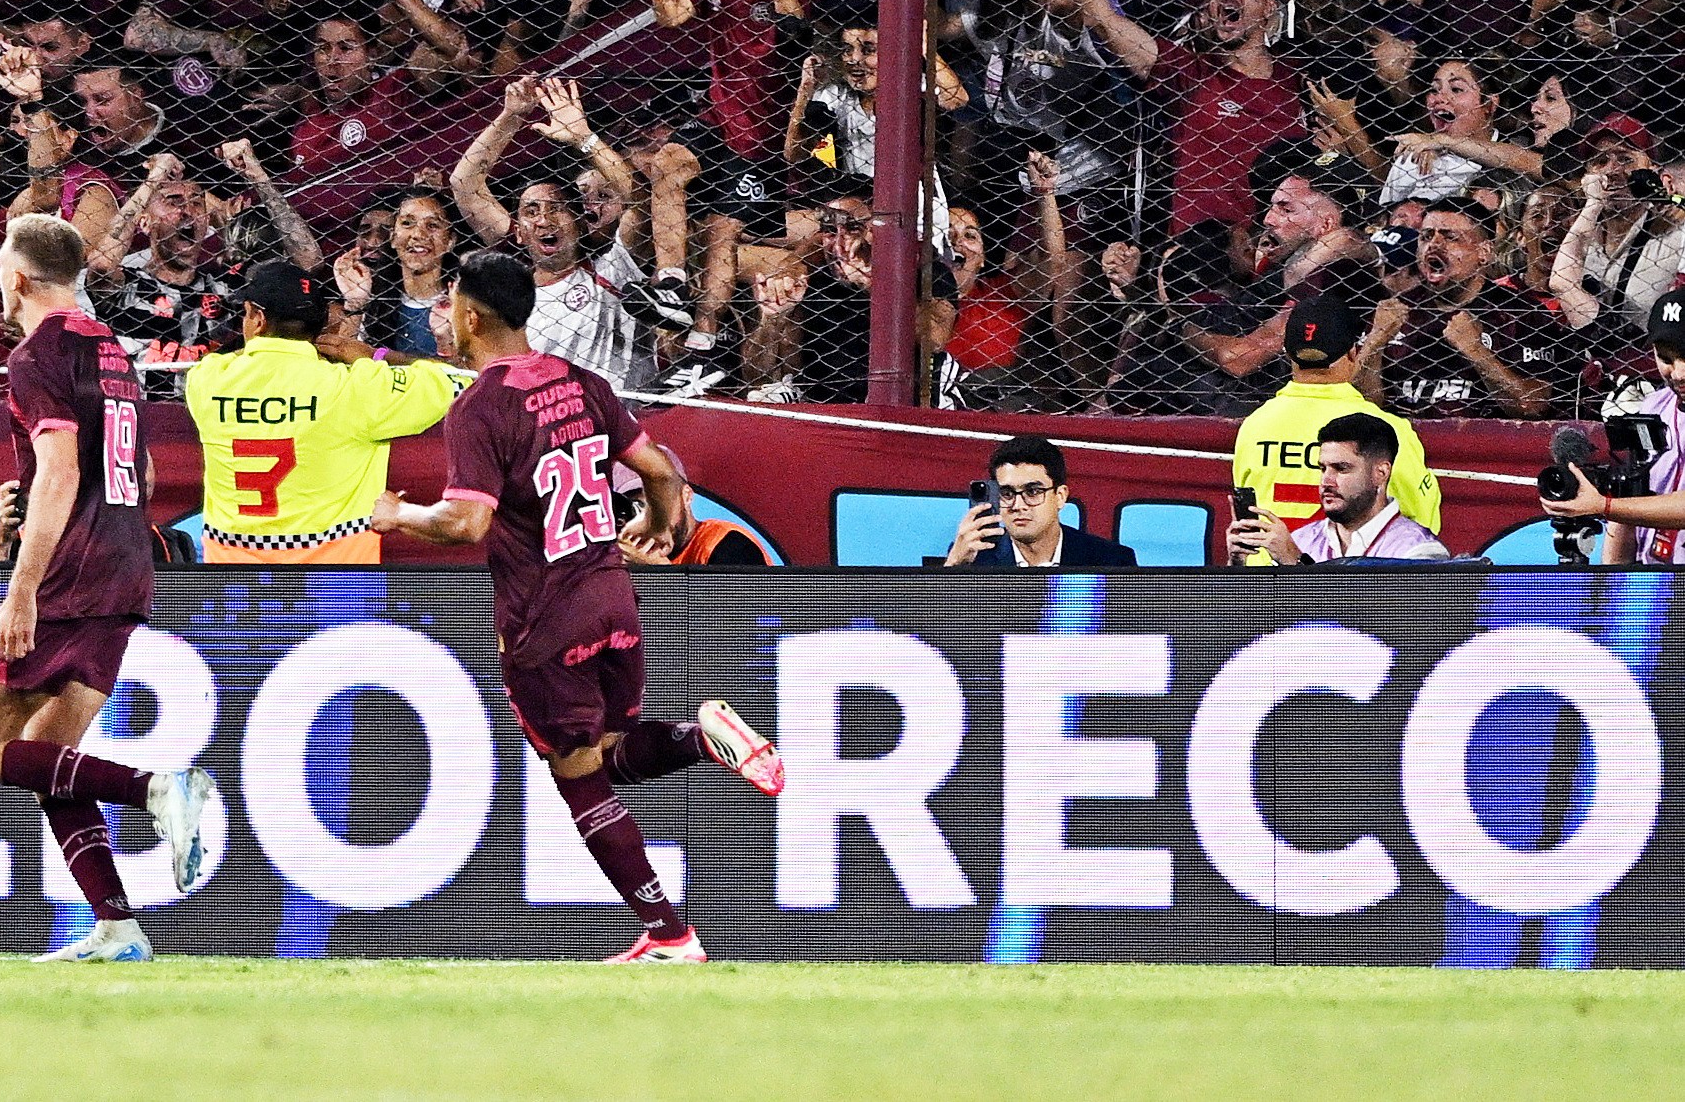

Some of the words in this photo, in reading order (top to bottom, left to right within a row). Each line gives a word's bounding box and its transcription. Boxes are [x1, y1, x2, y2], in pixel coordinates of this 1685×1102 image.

[103, 398, 140, 507] 19
[211, 395, 318, 425] TECH
[1256, 441, 1321, 469] TEC
[532, 434, 617, 564] 25
[775, 622, 1664, 916] RECO
